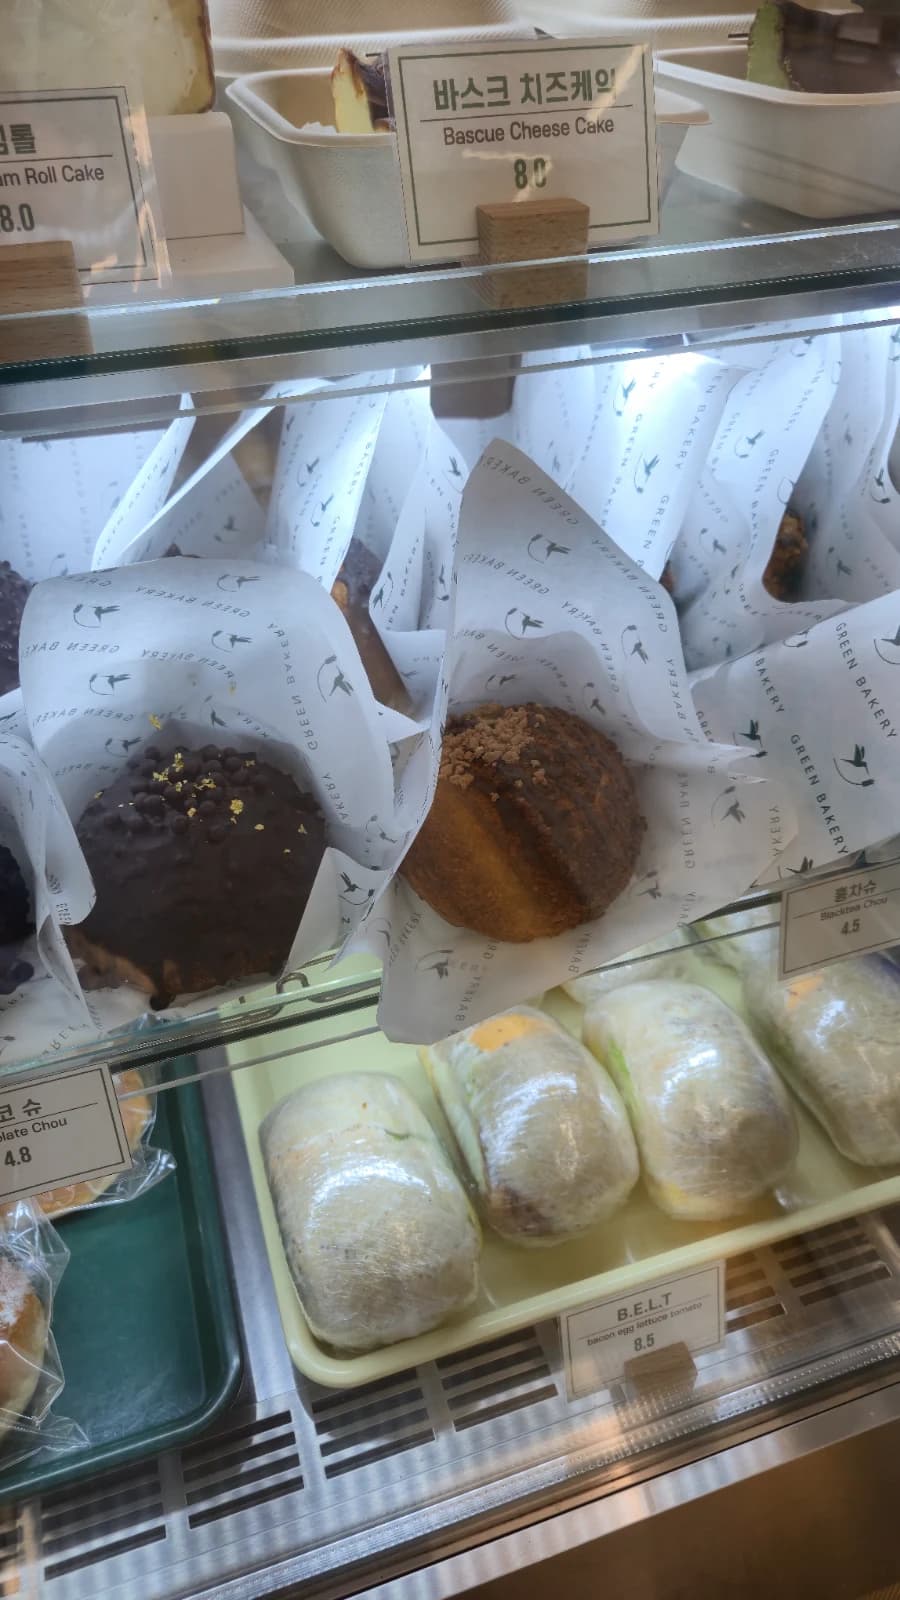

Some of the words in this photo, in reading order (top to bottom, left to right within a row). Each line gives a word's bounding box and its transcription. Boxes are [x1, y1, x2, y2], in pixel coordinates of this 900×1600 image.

[433, 75, 511, 111] 바스크
[443, 125, 505, 146] Bascue
[510, 120, 570, 142] Cheese
[575, 116, 615, 136] Cake
[24, 165, 58, 185] Roll
[61, 164, 105, 183] Cake
[514, 158, 547, 189] 80
[0, 203, 36, 233] 8.0
[643, 495, 670, 550] GREEN
[754, 656, 785, 714] BAKERY
[835, 622, 858, 670] GREEN
[855, 676, 898, 739] BAKERY
[790, 733, 820, 787] GREEN
[815, 793, 849, 855] BAKERY
[841, 918, 861, 935] 4.5
[0, 1127, 29, 1143] late
[32, 1117, 68, 1133] Chou
[4, 1146, 32, 1167] 4.8
[617, 1292, 672, 1322] B.E.L.T
[617, 1325, 634, 1337] egg
[633, 1333, 655, 1352] 8.5
